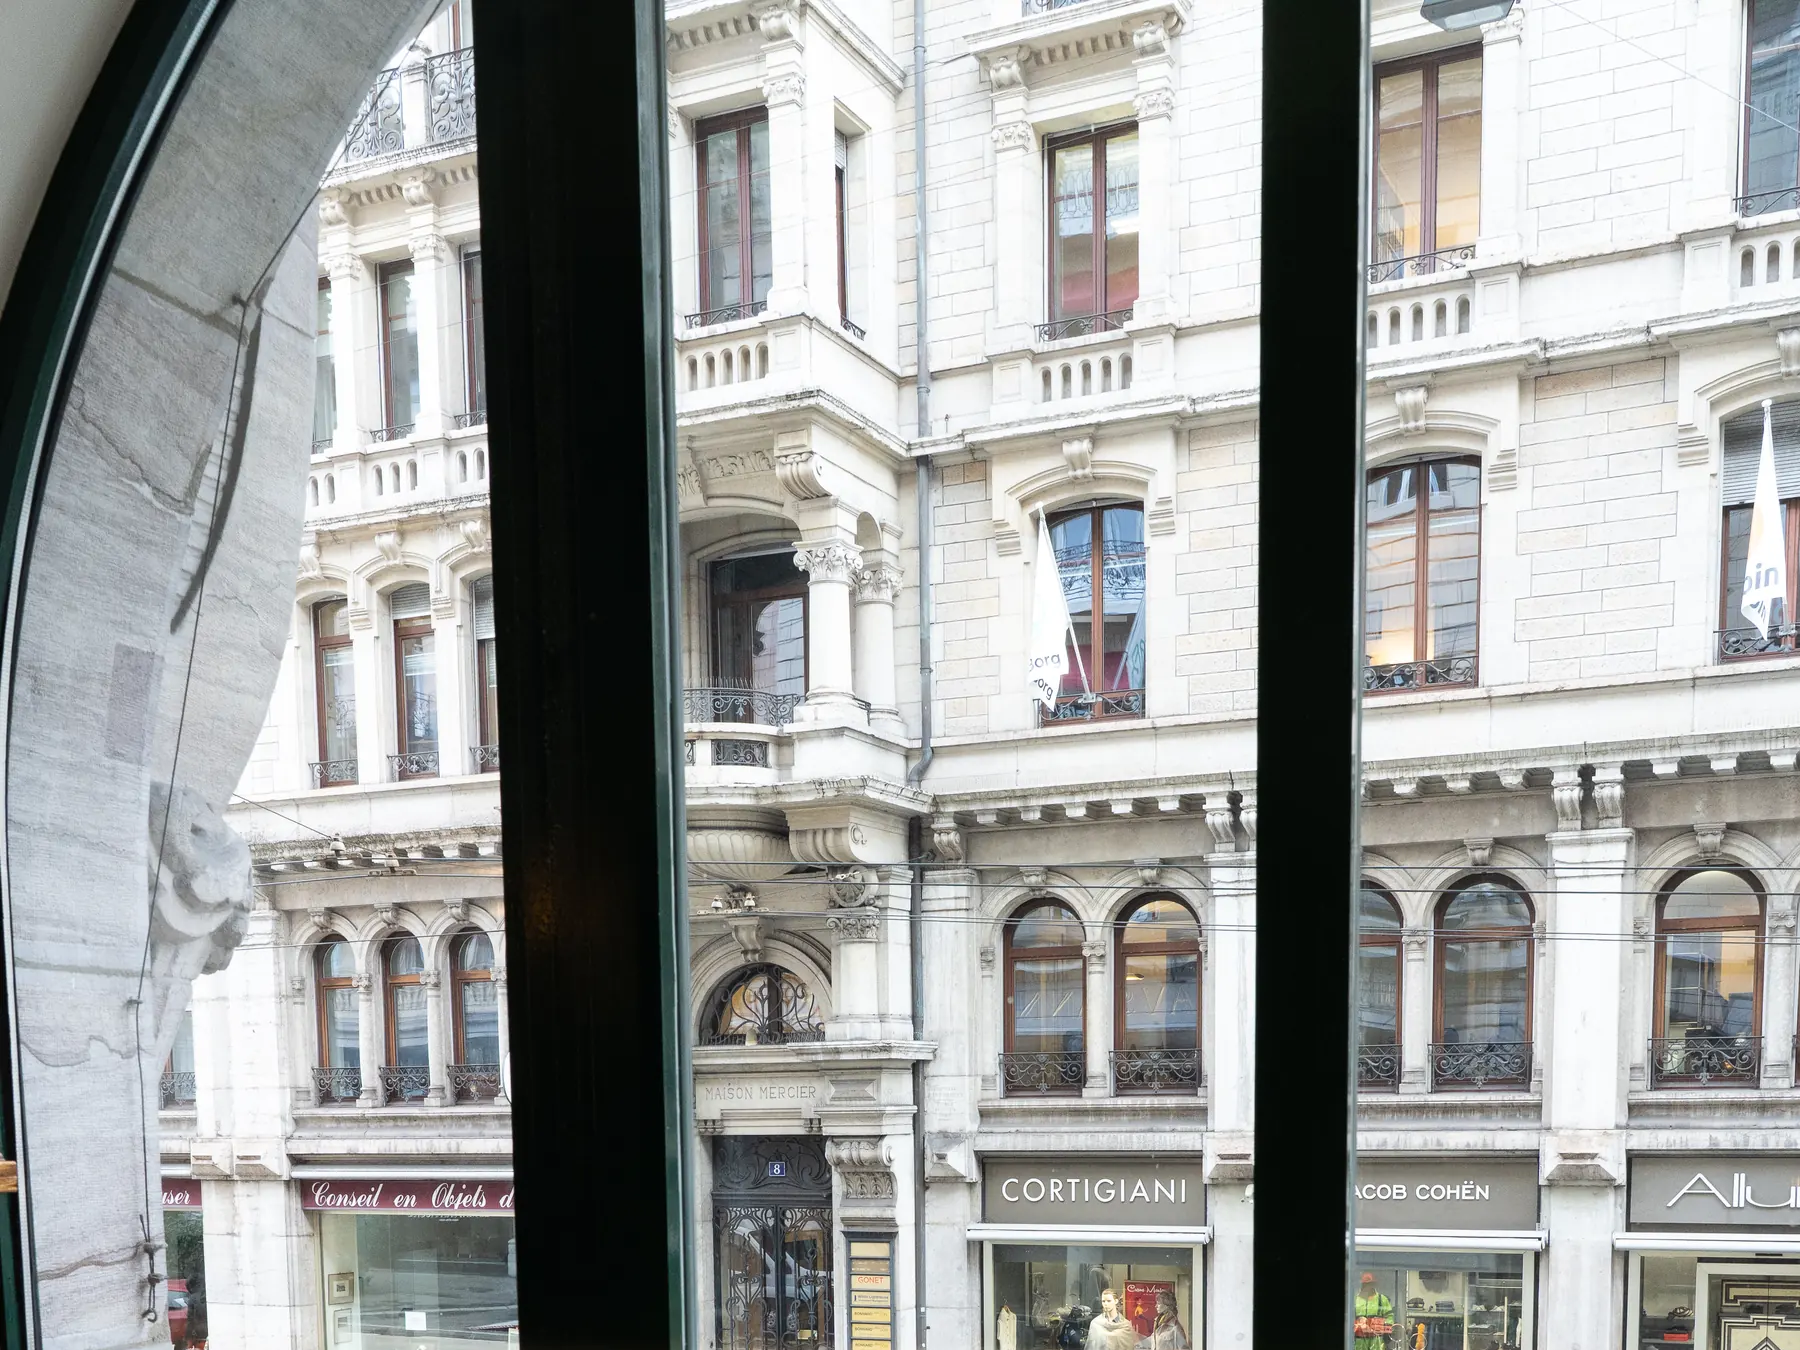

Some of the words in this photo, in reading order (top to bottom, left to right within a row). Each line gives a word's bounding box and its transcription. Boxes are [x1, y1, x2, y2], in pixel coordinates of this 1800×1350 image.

[705, 1087, 753, 1100] MAISON
[760, 1085, 816, 1099] MERCIER
[773, 1164, 781, 1175] 8
[311, 1182, 383, 1207] Conseil
[394, 1194, 417, 1207] en
[432, 1183, 487, 1209] Objets
[1001, 1178, 1187, 1203] CORTIGIANI
[1415, 1180, 1490, 1200] COHËN
[857, 1276, 884, 1284] GONET
